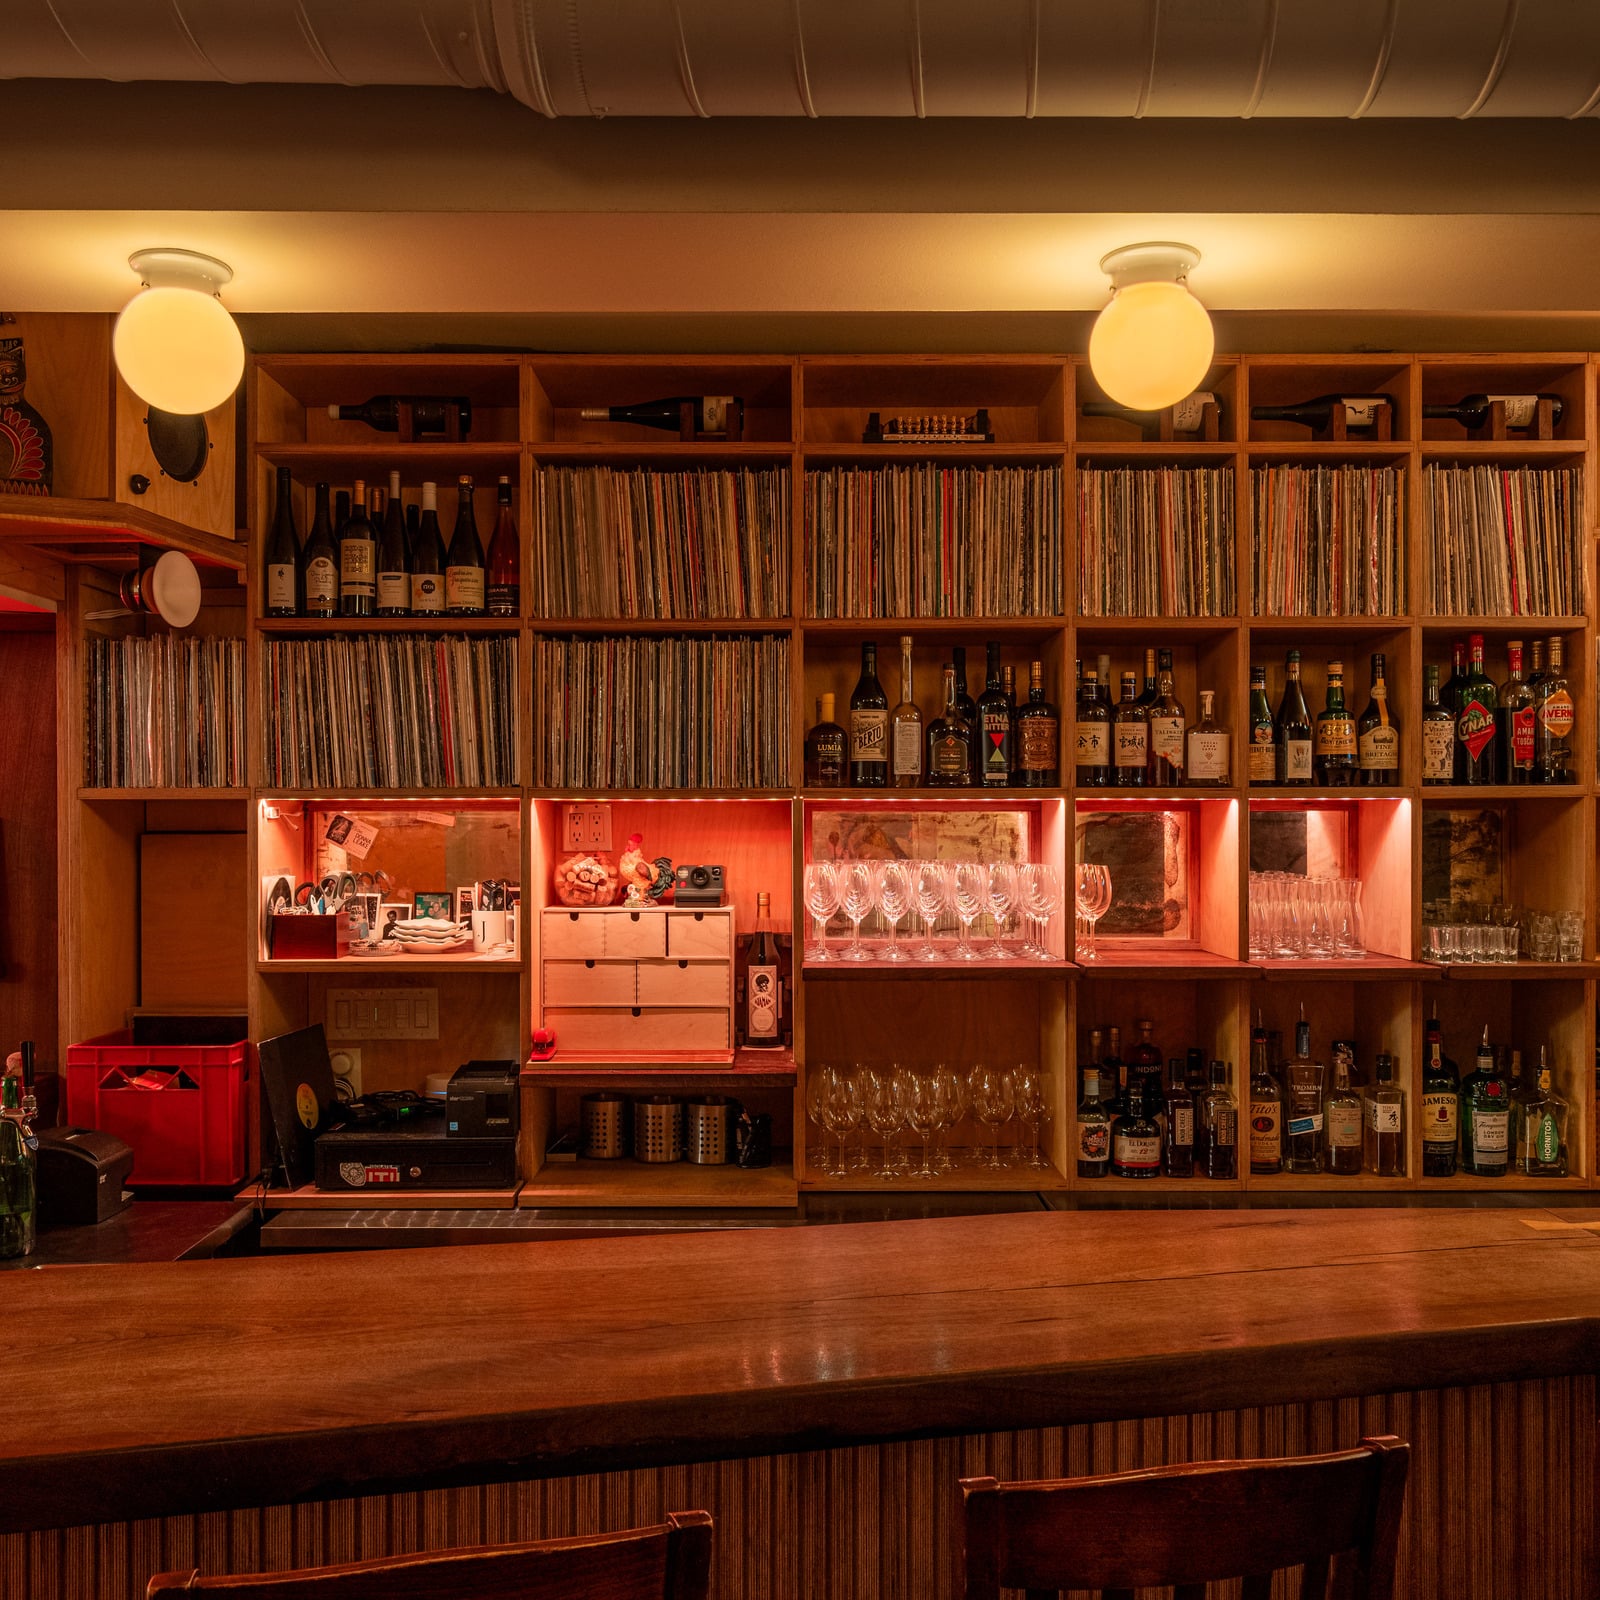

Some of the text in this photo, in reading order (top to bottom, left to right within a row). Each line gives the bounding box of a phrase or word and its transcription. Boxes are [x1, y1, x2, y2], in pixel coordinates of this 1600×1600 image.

[858, 725, 882, 749] BERTO
[1457, 713, 1494, 741] CYNAR
[1544, 1120, 1552, 1161] HORNITOS
